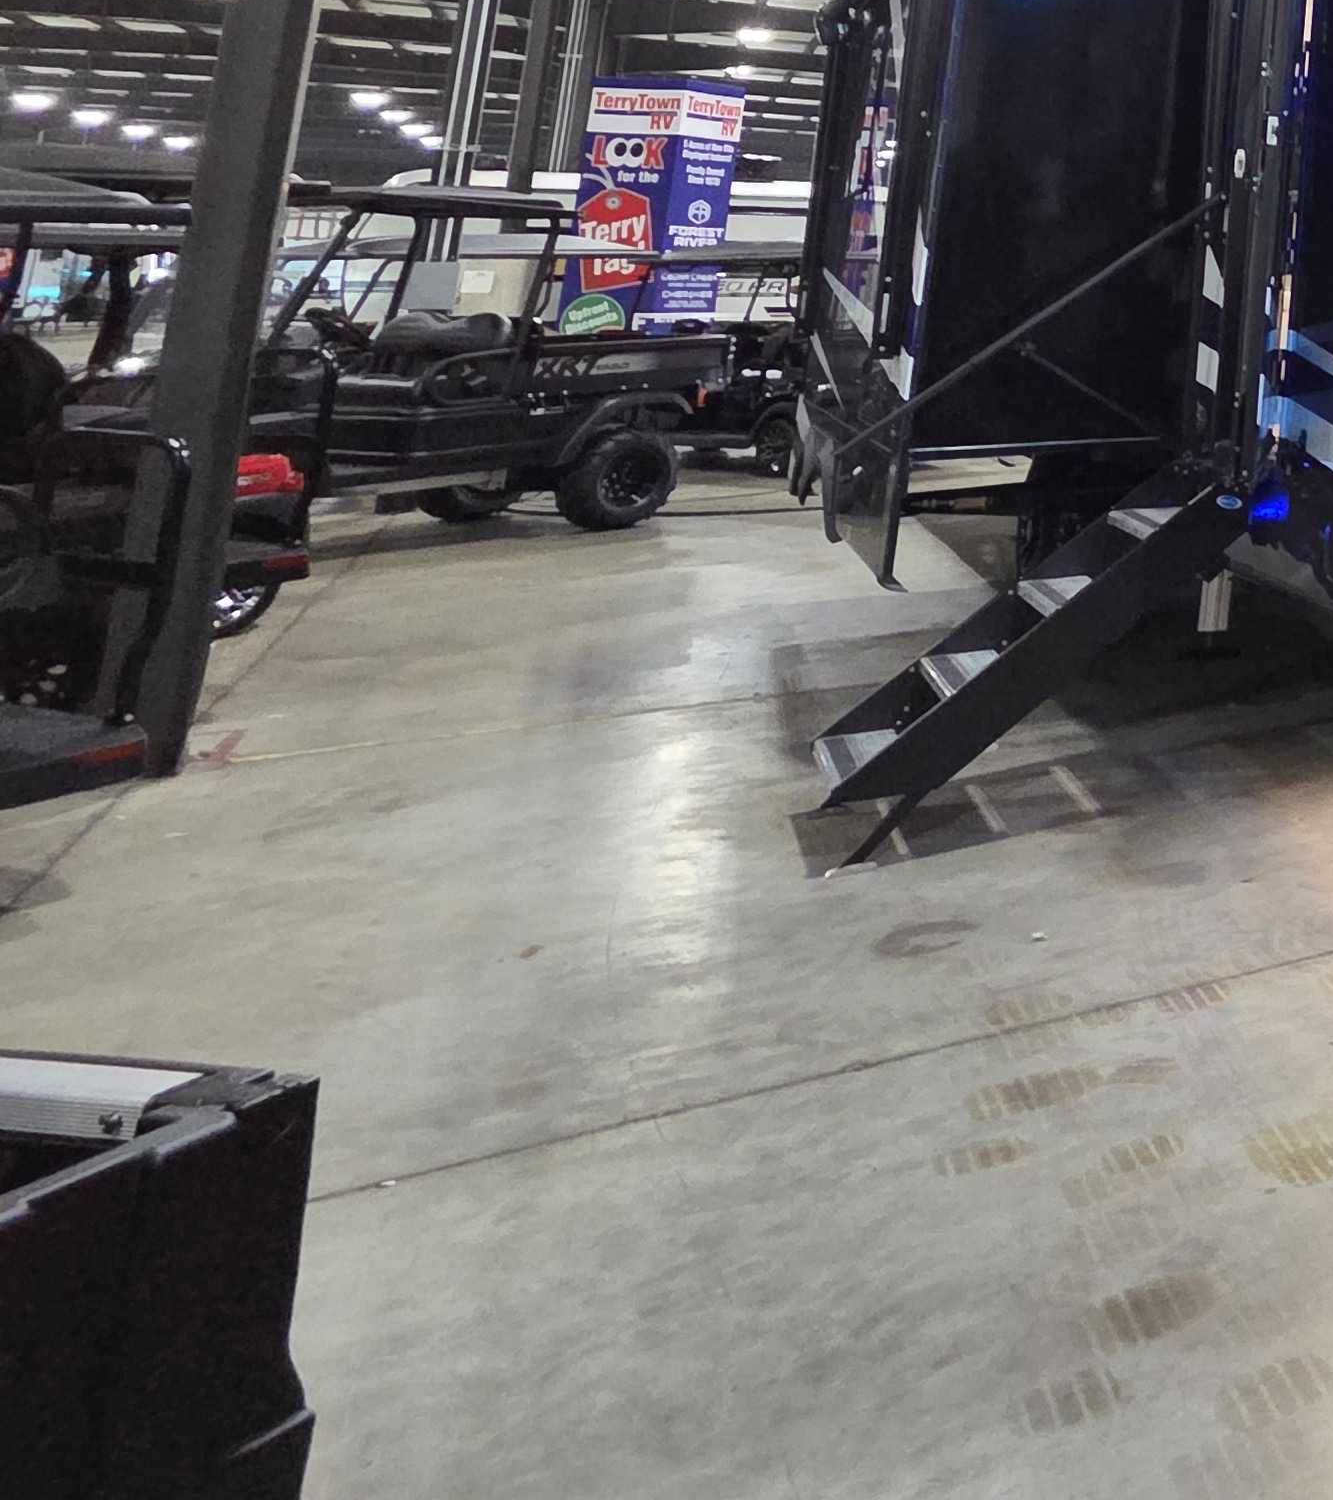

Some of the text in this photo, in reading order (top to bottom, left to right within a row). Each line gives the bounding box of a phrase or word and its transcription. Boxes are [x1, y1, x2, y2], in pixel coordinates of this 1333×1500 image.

[595, 91, 681, 113] TerryTown
[688, 95, 742, 119] TerryTown
[649, 113, 677, 130] RV
[721, 120, 738, 136] RV
[591, 134, 668, 170] LOOK
[616, 170, 660, 184] for the
[580, 214, 646, 241] Terry
[668, 225, 725, 238] FOREST
